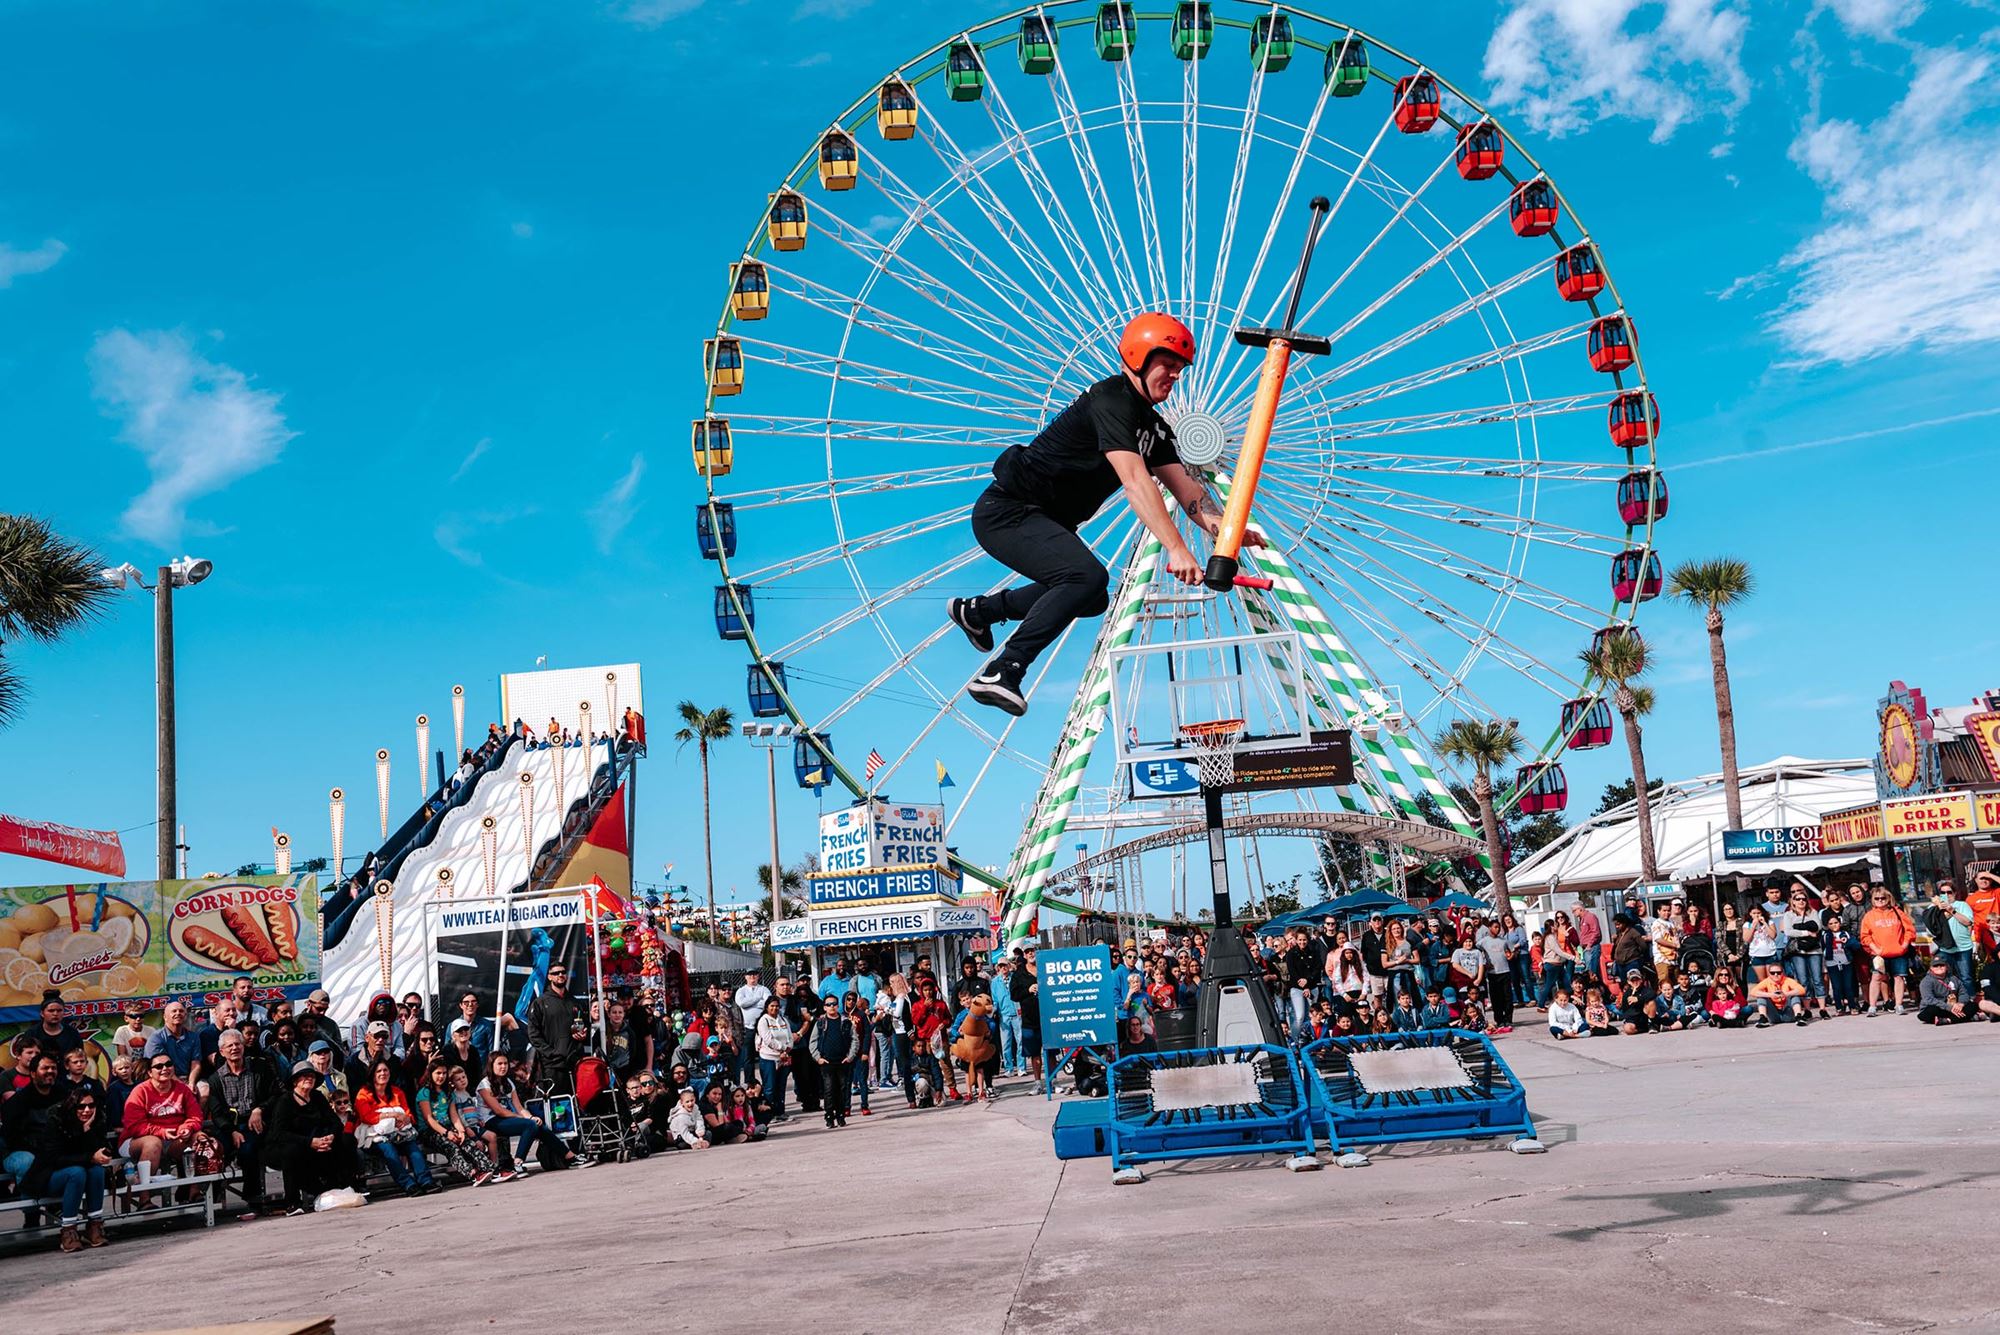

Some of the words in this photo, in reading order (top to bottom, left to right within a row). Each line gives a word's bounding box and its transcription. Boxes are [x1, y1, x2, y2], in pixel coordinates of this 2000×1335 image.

[1148, 762, 1178, 775] FL
[1149, 774, 1179, 786] SF
[1904, 807, 1950, 820] COLD
[874, 822, 943, 843] FRENCH
[1754, 827, 1784, 842] ICE
[1789, 825, 1823, 840] COL
[1893, 818, 1966, 834] DRINKS
[821, 823, 869, 852] FRENCH
[882, 845, 938, 864] FRIES
[1728, 847, 1745, 855] BUD
[1745, 846, 1767, 854] LIGHT
[1773, 840, 1820, 856] BEER
[827, 847, 865, 871] FRIES
[815, 877, 879, 899] FRENCH
[886, 874, 932, 893] FRIES
[1654, 885, 1673, 893] ATM
[174, 892, 233, 918] CORN
[239, 888, 297, 905] DOGS
[442, 902, 579, 928] WWW.TEAMBIGAIR.COM
[939, 910, 976, 922] Fiske
[776, 924, 805, 937] Fiske
[820, 918, 877, 936] FRENCH
[882, 915, 923, 931] FRIES
[1045, 960, 1071, 974] BIG
[1075, 958, 1101, 971] AIR
[166, 980, 218, 992] FRESH
[225, 972, 317, 990] LONADE
[1046, 976, 1055, 986] &
[1058, 972, 1102, 985] XPOGO
[203, 987, 286, 1005] STCK
